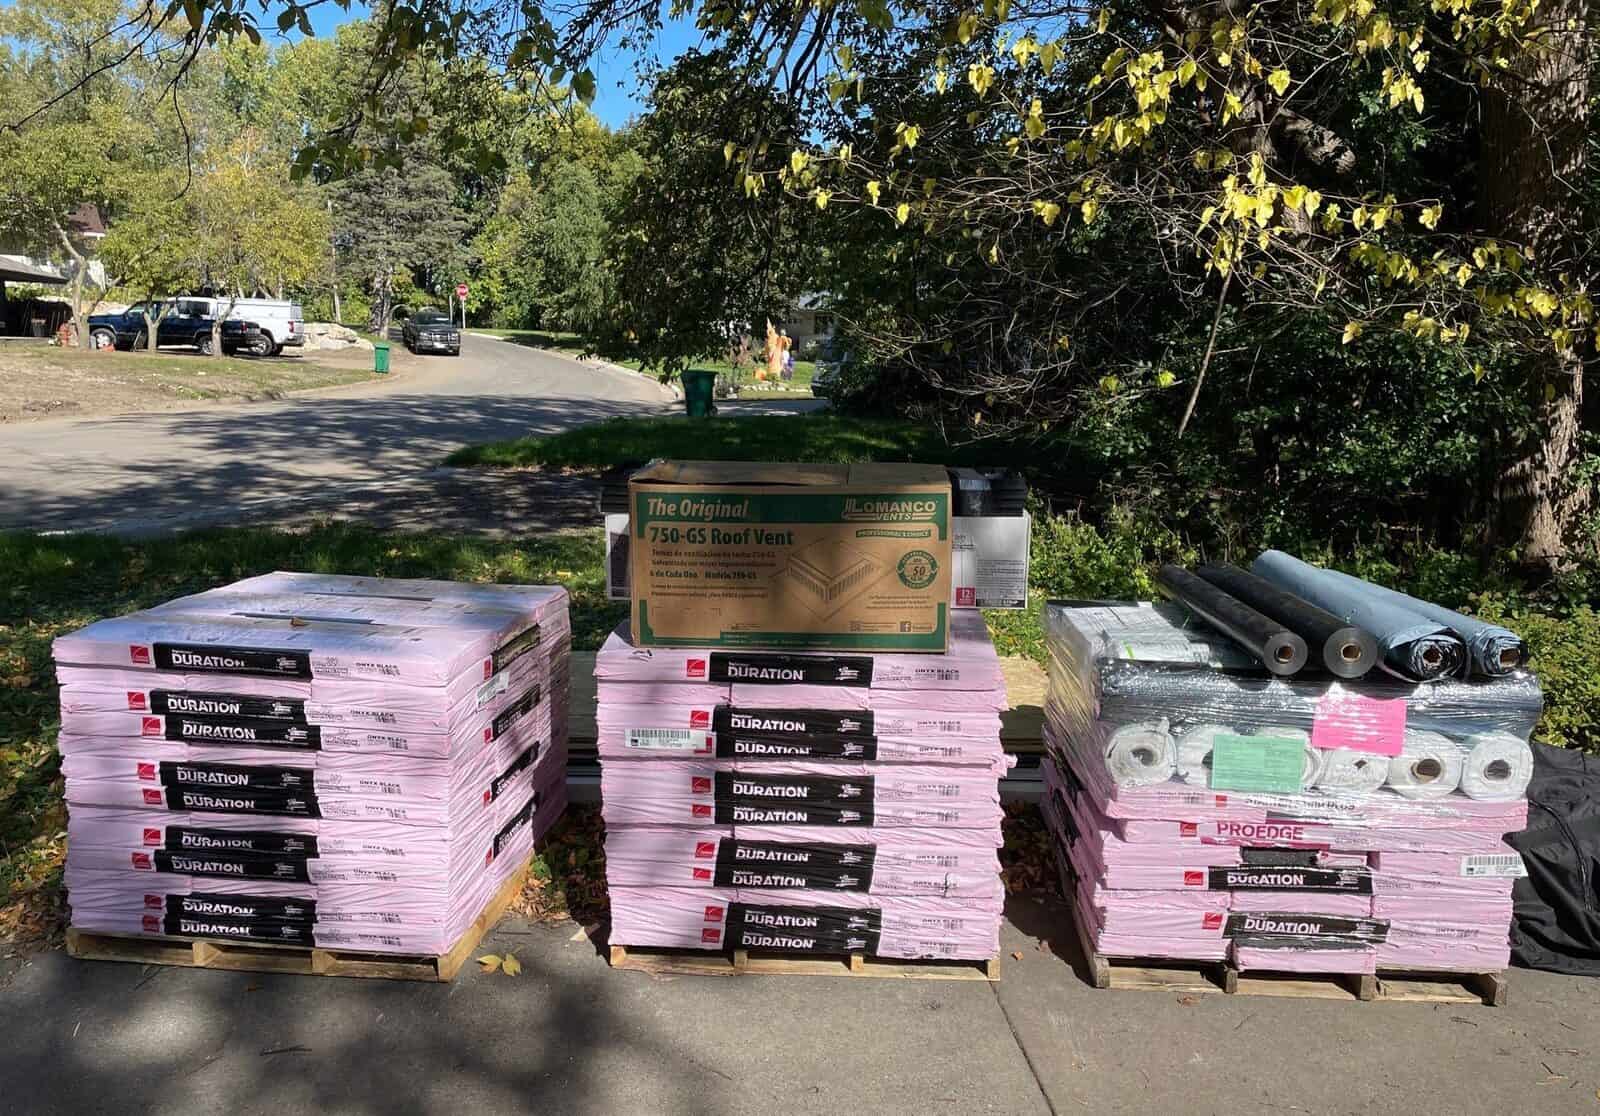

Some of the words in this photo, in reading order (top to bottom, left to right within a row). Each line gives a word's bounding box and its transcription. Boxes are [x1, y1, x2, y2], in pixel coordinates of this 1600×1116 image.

[648, 499, 676, 515] The
[680, 499, 749, 520] Original
[848, 499, 936, 513] LOMANCO
[877, 512, 912, 520] VENTS
[651, 527, 707, 544] 750-GS
[712, 527, 751, 545] Roof
[753, 528, 793, 545] Vent
[727, 666, 804, 681] DURATION
[168, 698, 240, 714] DURATION
[182, 724, 256, 740] DURATION
[731, 718, 806, 732] DURATION
[735, 742, 810, 754] DURATION
[177, 770, 249, 786] DURATION
[733, 783, 808, 798] DURATION
[184, 795, 255, 809] DURATION
[734, 811, 808, 822] DURATION
[1216, 820, 1304, 840] PROEDGE
[736, 849, 809, 862] DURATION
[171, 859, 244, 874] DURATION
[732, 873, 806, 887] DURATION
[1227, 874, 1304, 885] DURATION
[182, 901, 253, 914] DURATION
[744, 913, 817, 927] DURATION
[1244, 919, 1320, 934] DURATION
[181, 924, 250, 936] DURATION
[742, 935, 814, 949] DURATION
